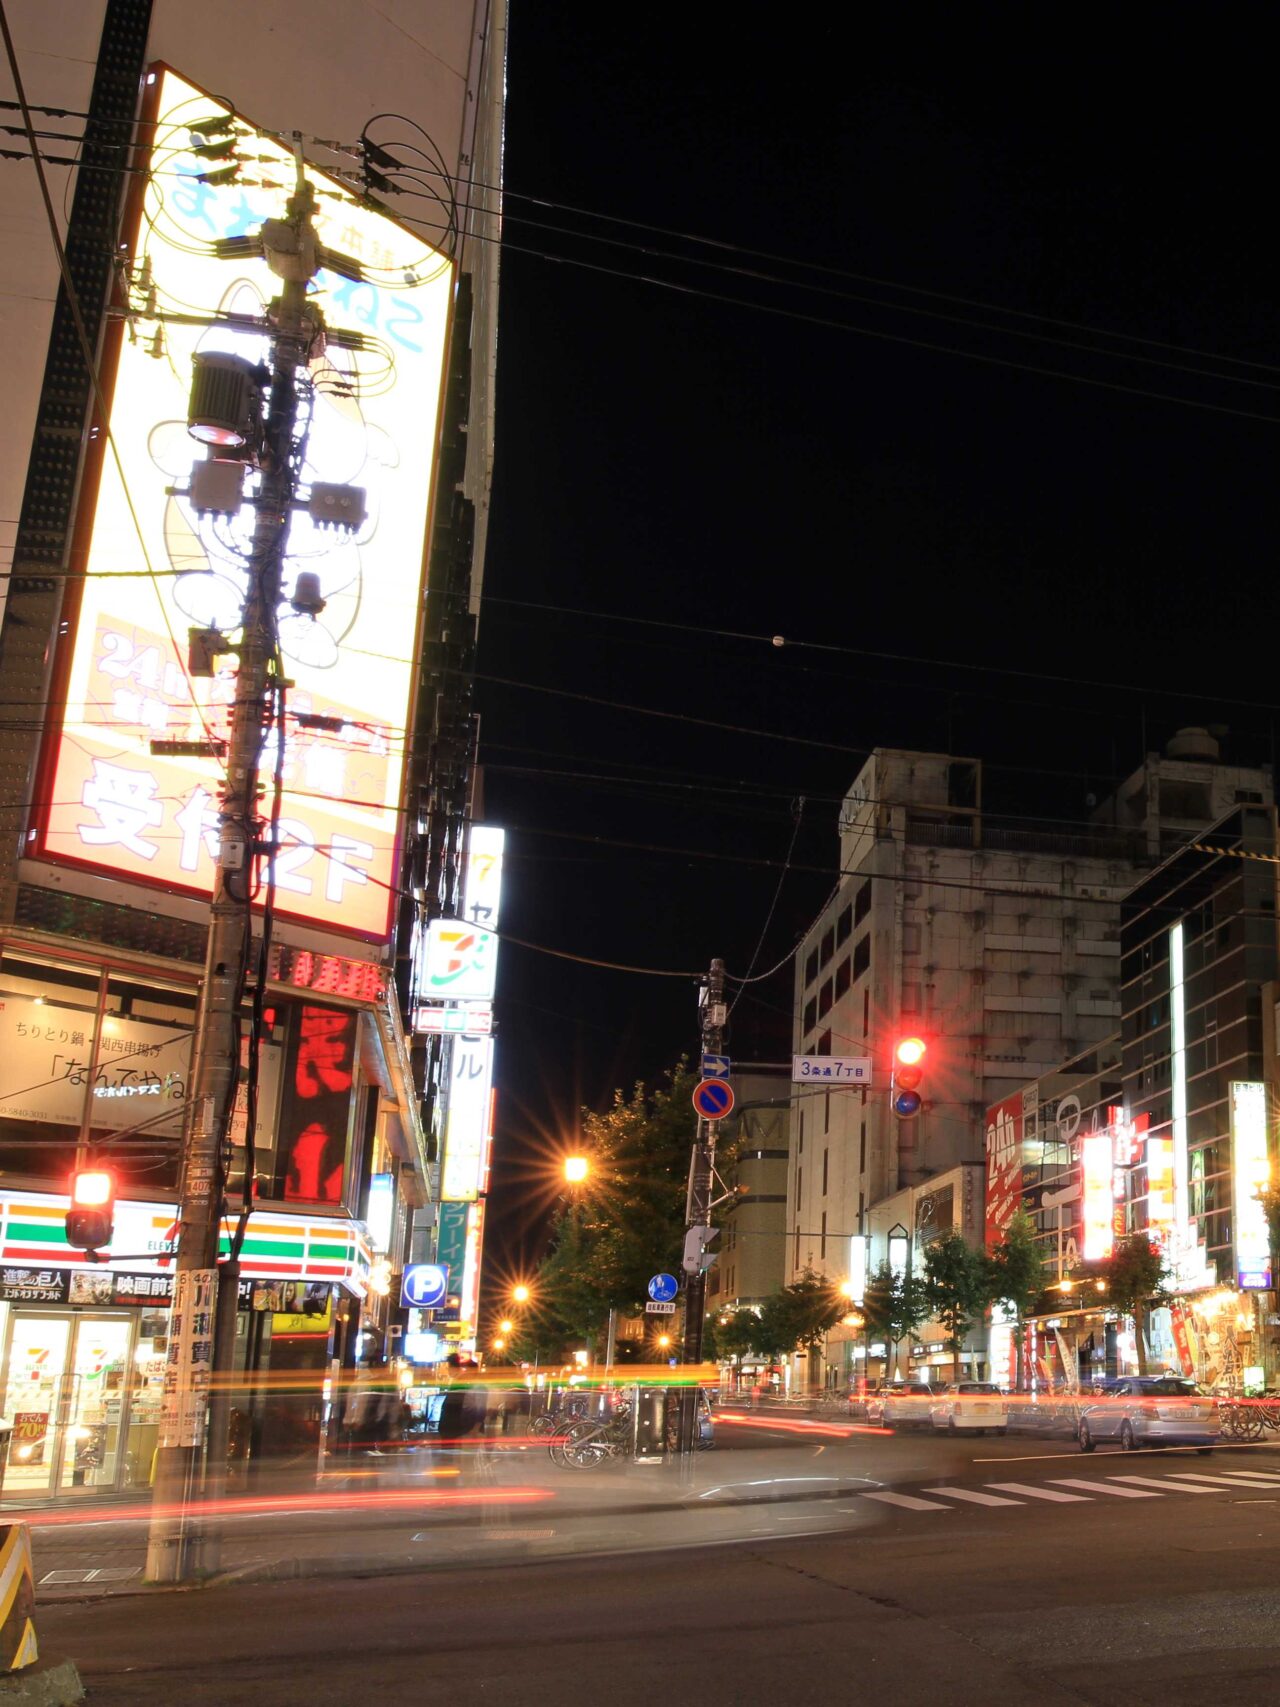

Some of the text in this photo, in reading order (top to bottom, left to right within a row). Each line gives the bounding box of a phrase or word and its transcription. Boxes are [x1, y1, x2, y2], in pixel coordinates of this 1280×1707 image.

[800, 1061, 864, 1078] 3条通7丁目
[3, 1267, 65, 1288] 進撃の巨人
[413, 1272, 443, 1301] P
